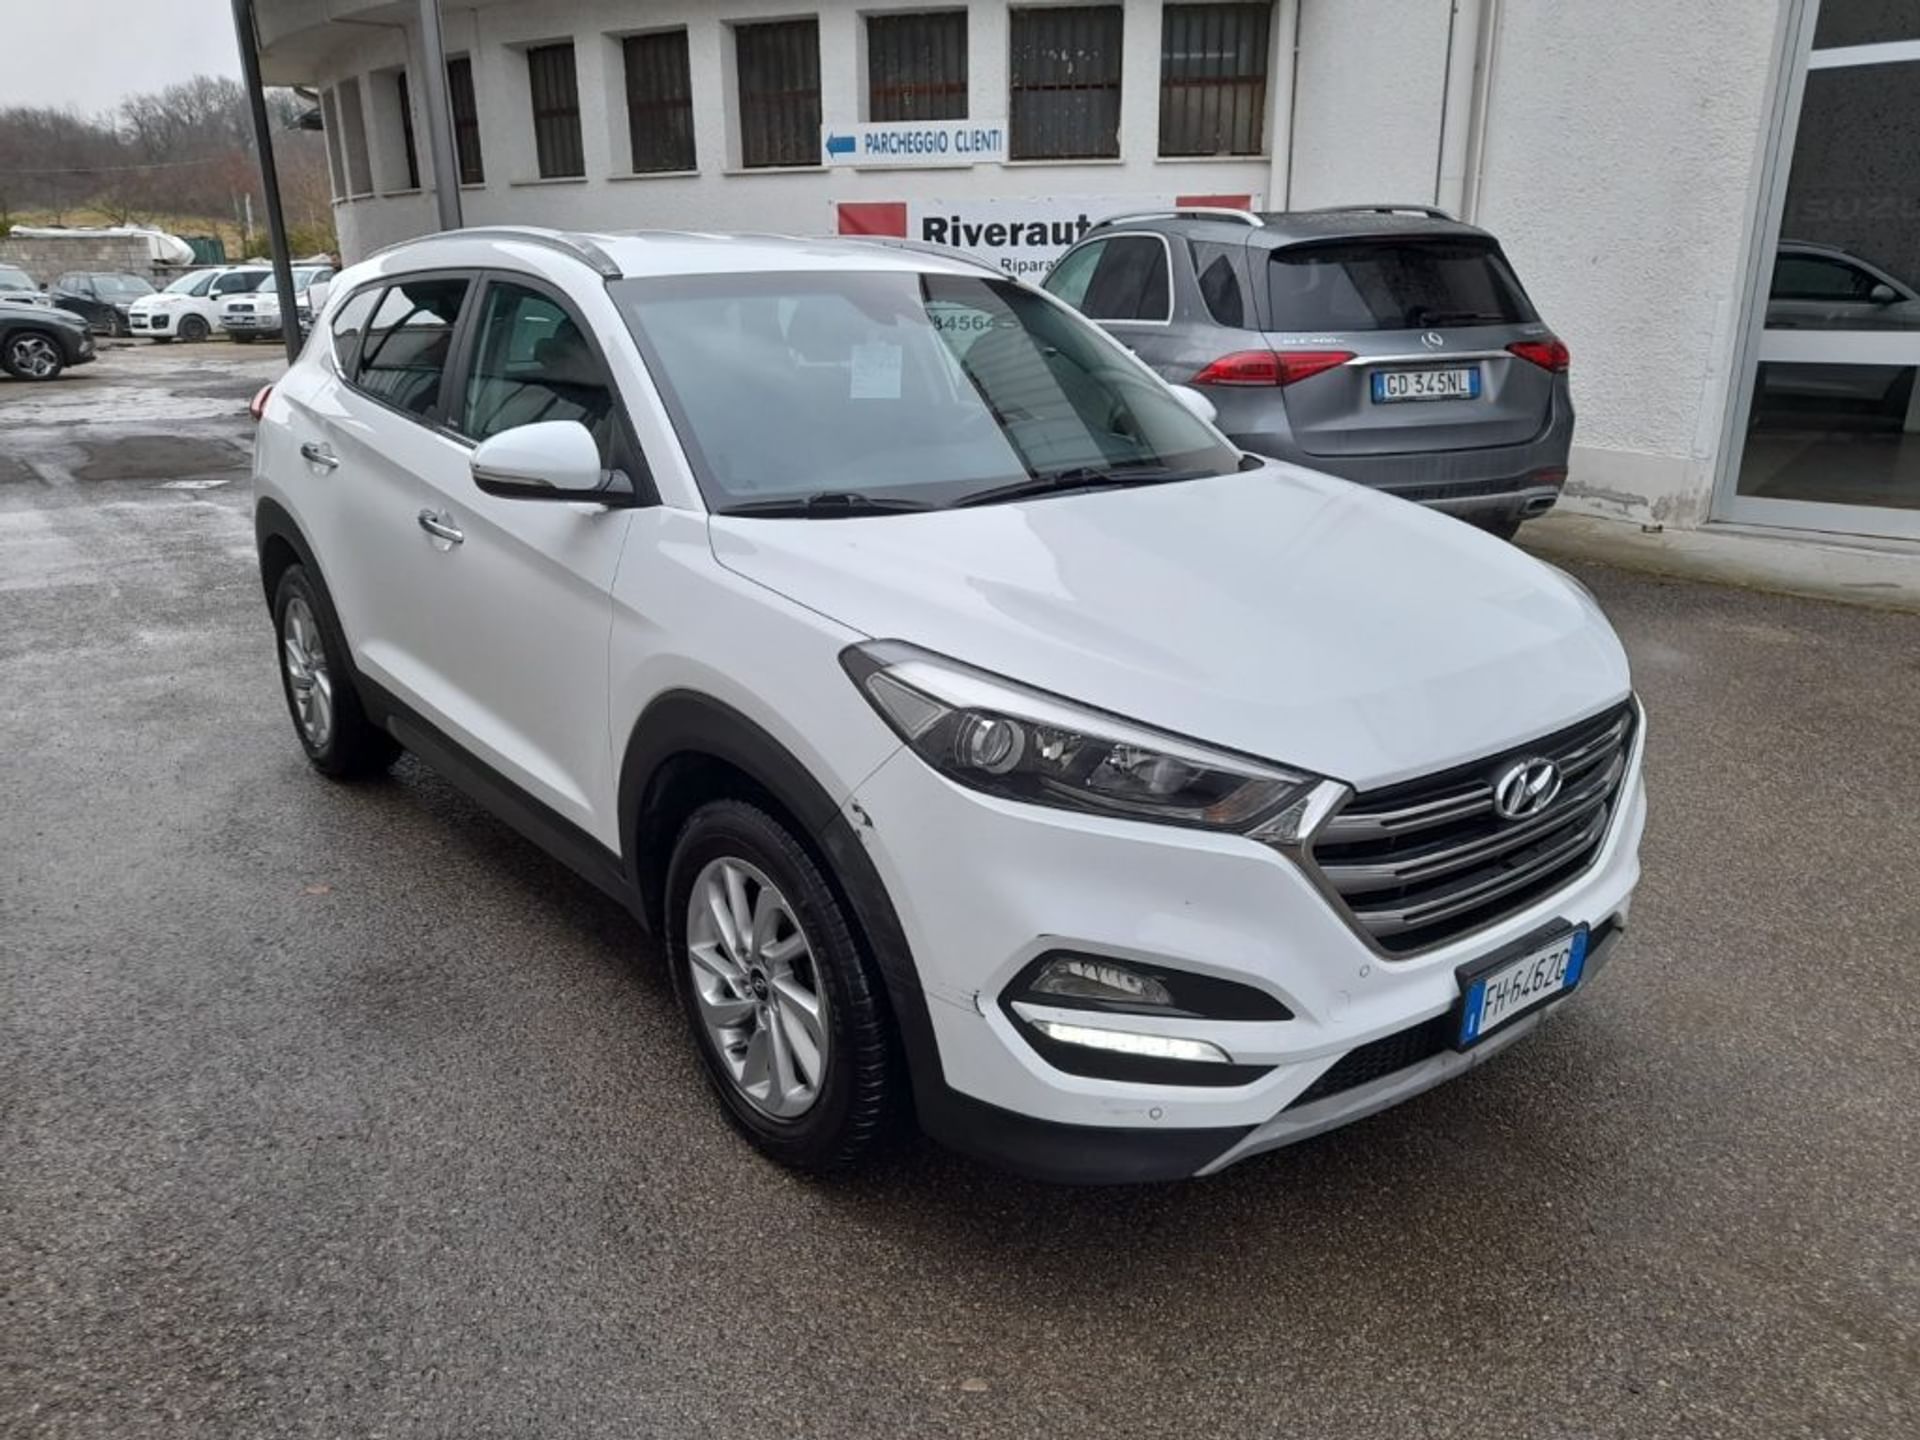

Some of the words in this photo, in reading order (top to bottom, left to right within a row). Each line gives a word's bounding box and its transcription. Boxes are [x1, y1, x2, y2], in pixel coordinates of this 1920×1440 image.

[864, 131, 948, 154] PARCHEGGIO
[955, 129, 1002, 153] CLIENTI
[1000, 257, 1059, 275] Ripara
[1387, 375, 1408, 395] GD
[1415, 372, 1467, 394] 345NL
